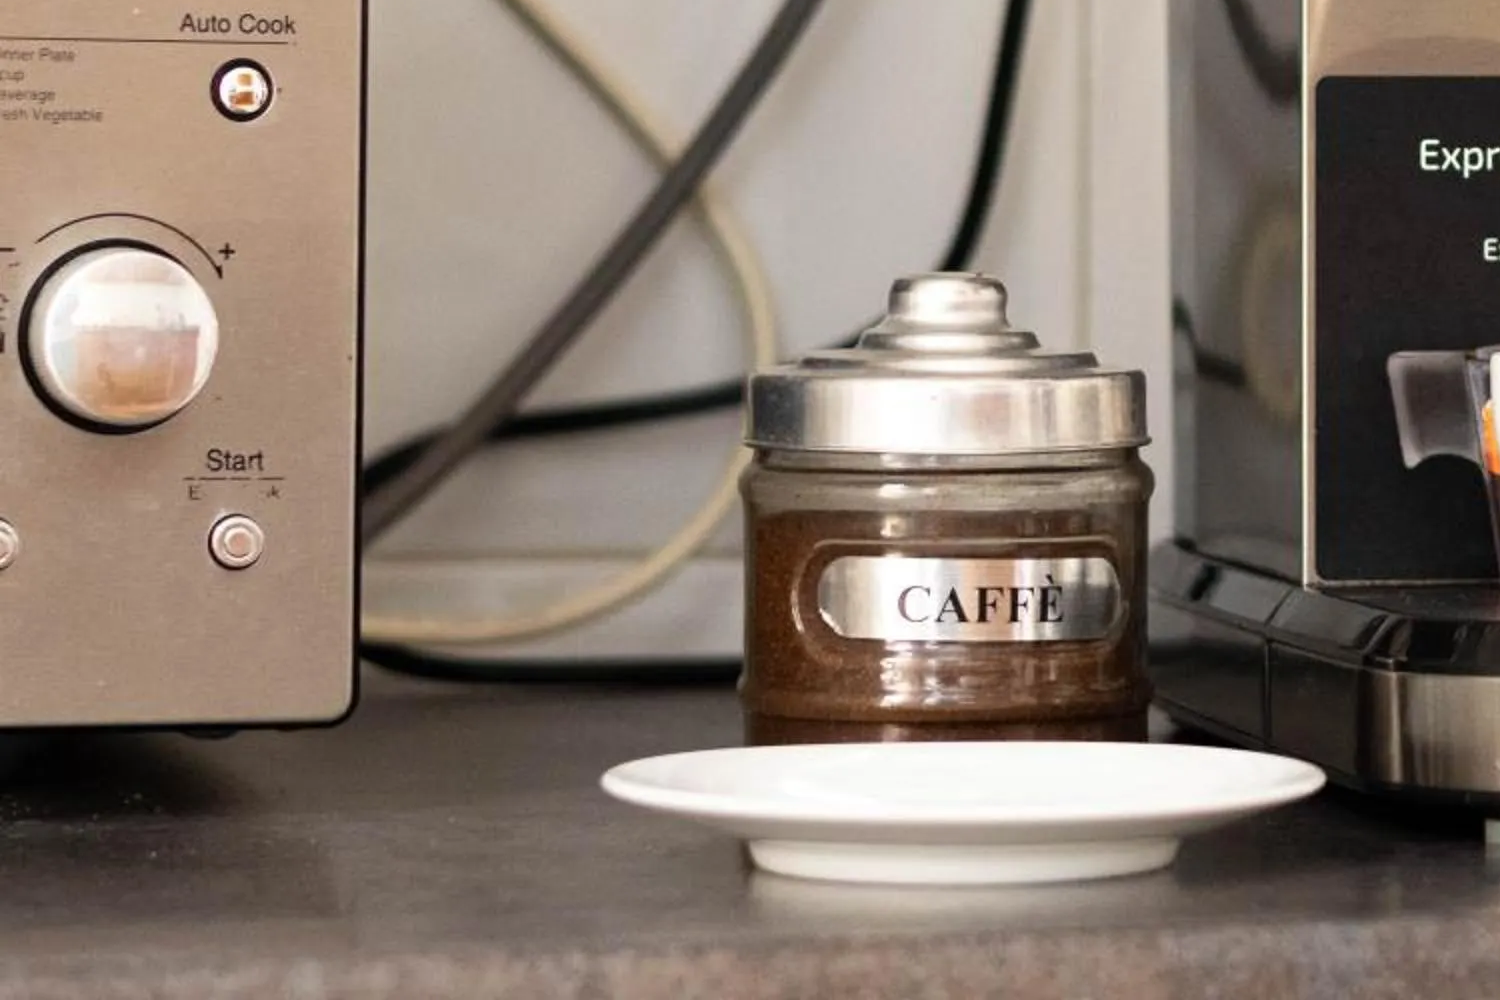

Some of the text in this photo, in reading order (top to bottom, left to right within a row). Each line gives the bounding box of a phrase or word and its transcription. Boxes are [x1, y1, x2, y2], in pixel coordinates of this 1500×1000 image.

[180, 13, 296, 35] Auto Cook
[207, 448, 264, 472] Start
[897, 575, 1064, 624] CAFFÈ
